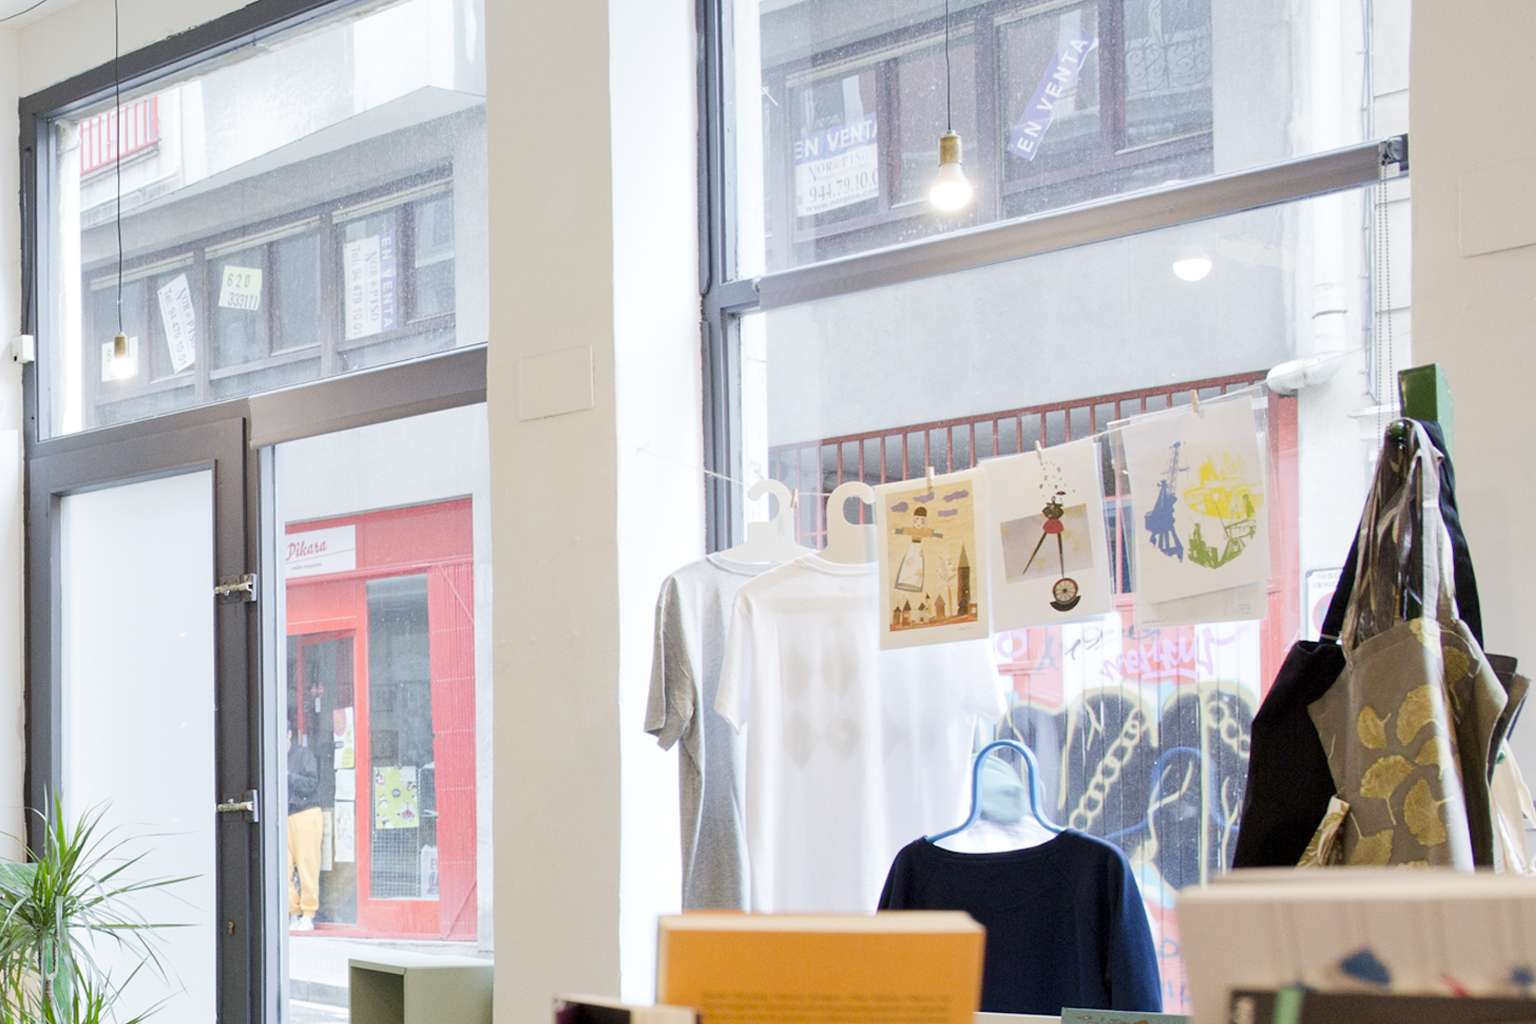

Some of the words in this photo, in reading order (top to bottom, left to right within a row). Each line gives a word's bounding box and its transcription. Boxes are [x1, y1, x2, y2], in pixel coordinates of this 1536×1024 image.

[1017, 121, 1042, 153] EN
[1036, 39, 1089, 112] VENTA
[286, 540, 328, 561] Pikara
